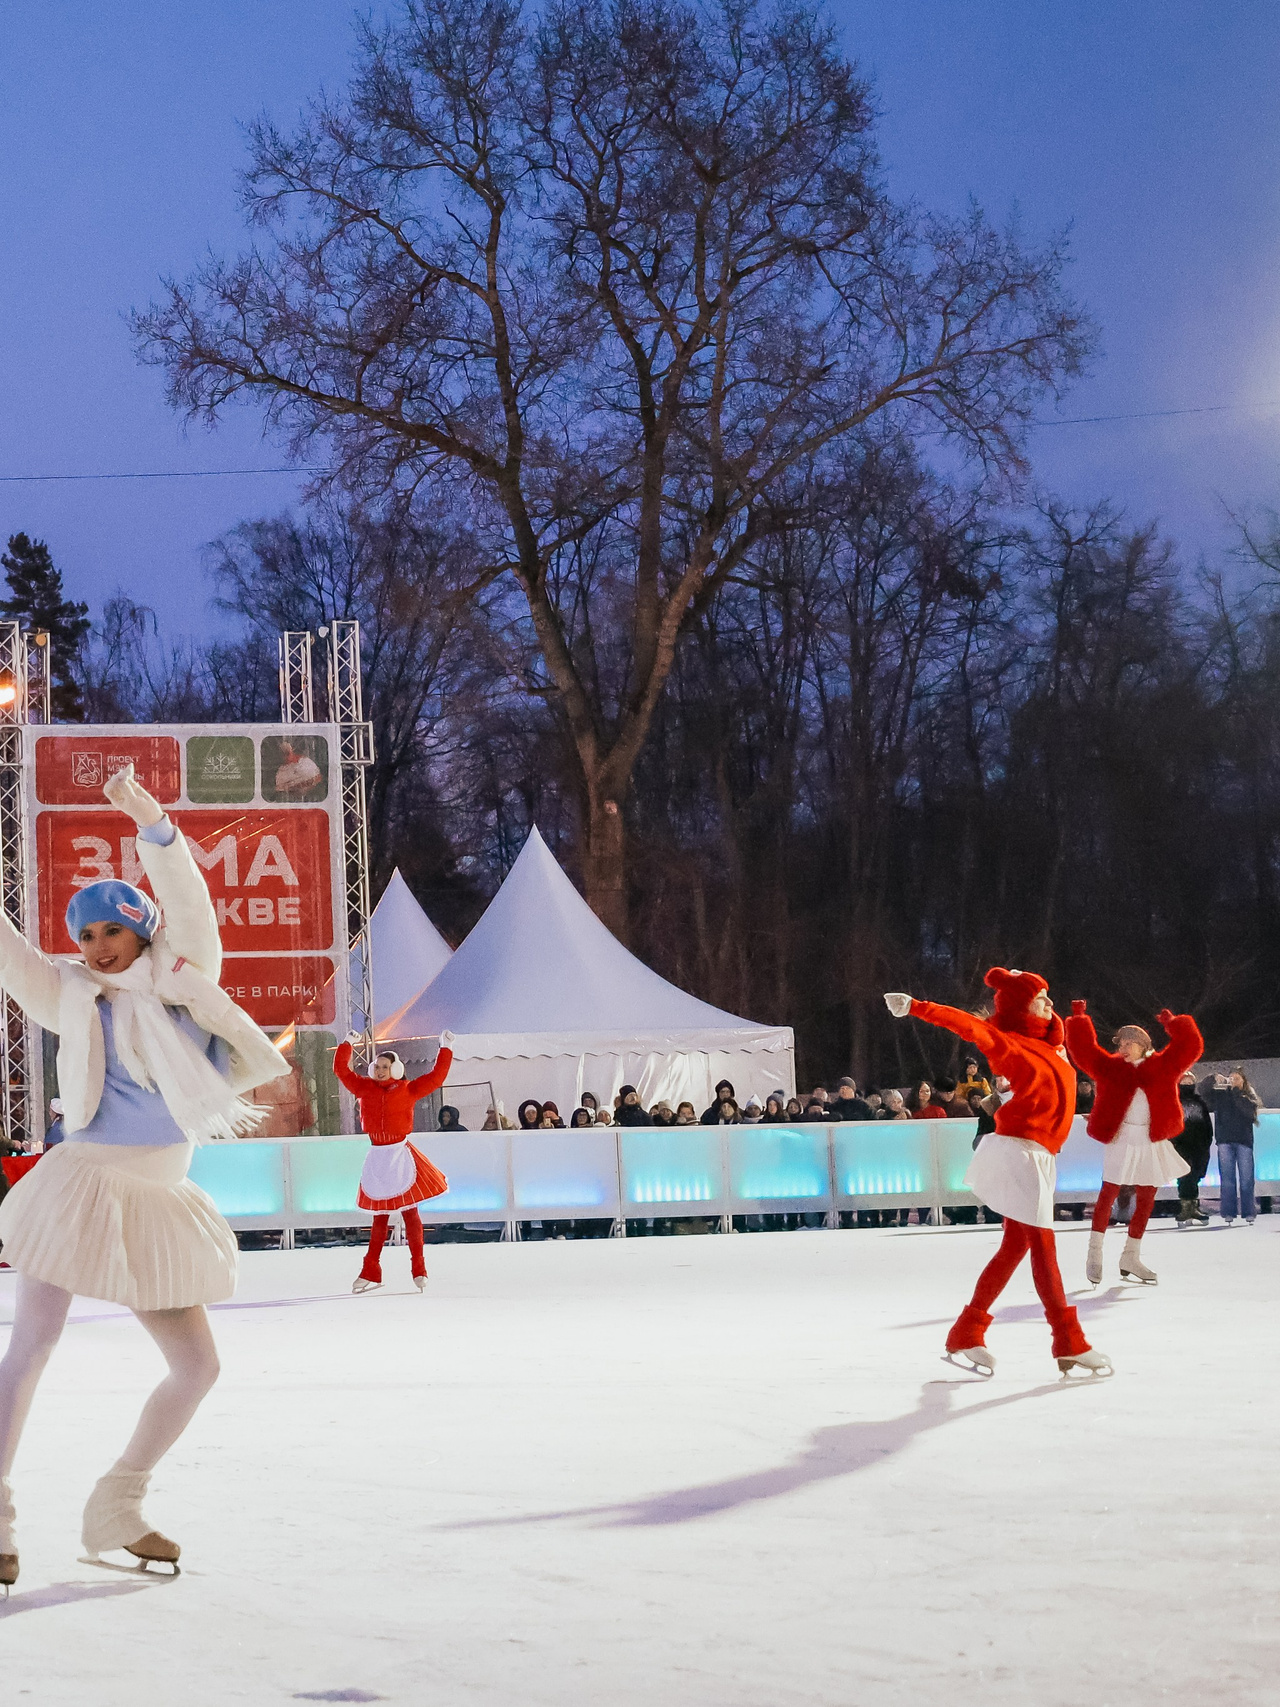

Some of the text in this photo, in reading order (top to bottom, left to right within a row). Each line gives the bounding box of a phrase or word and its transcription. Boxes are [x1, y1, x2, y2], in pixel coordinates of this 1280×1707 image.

[107, 755, 139, 763] ПРОЕКТ
[224, 986, 245, 998] СЕ
[251, 986, 262, 997] В
